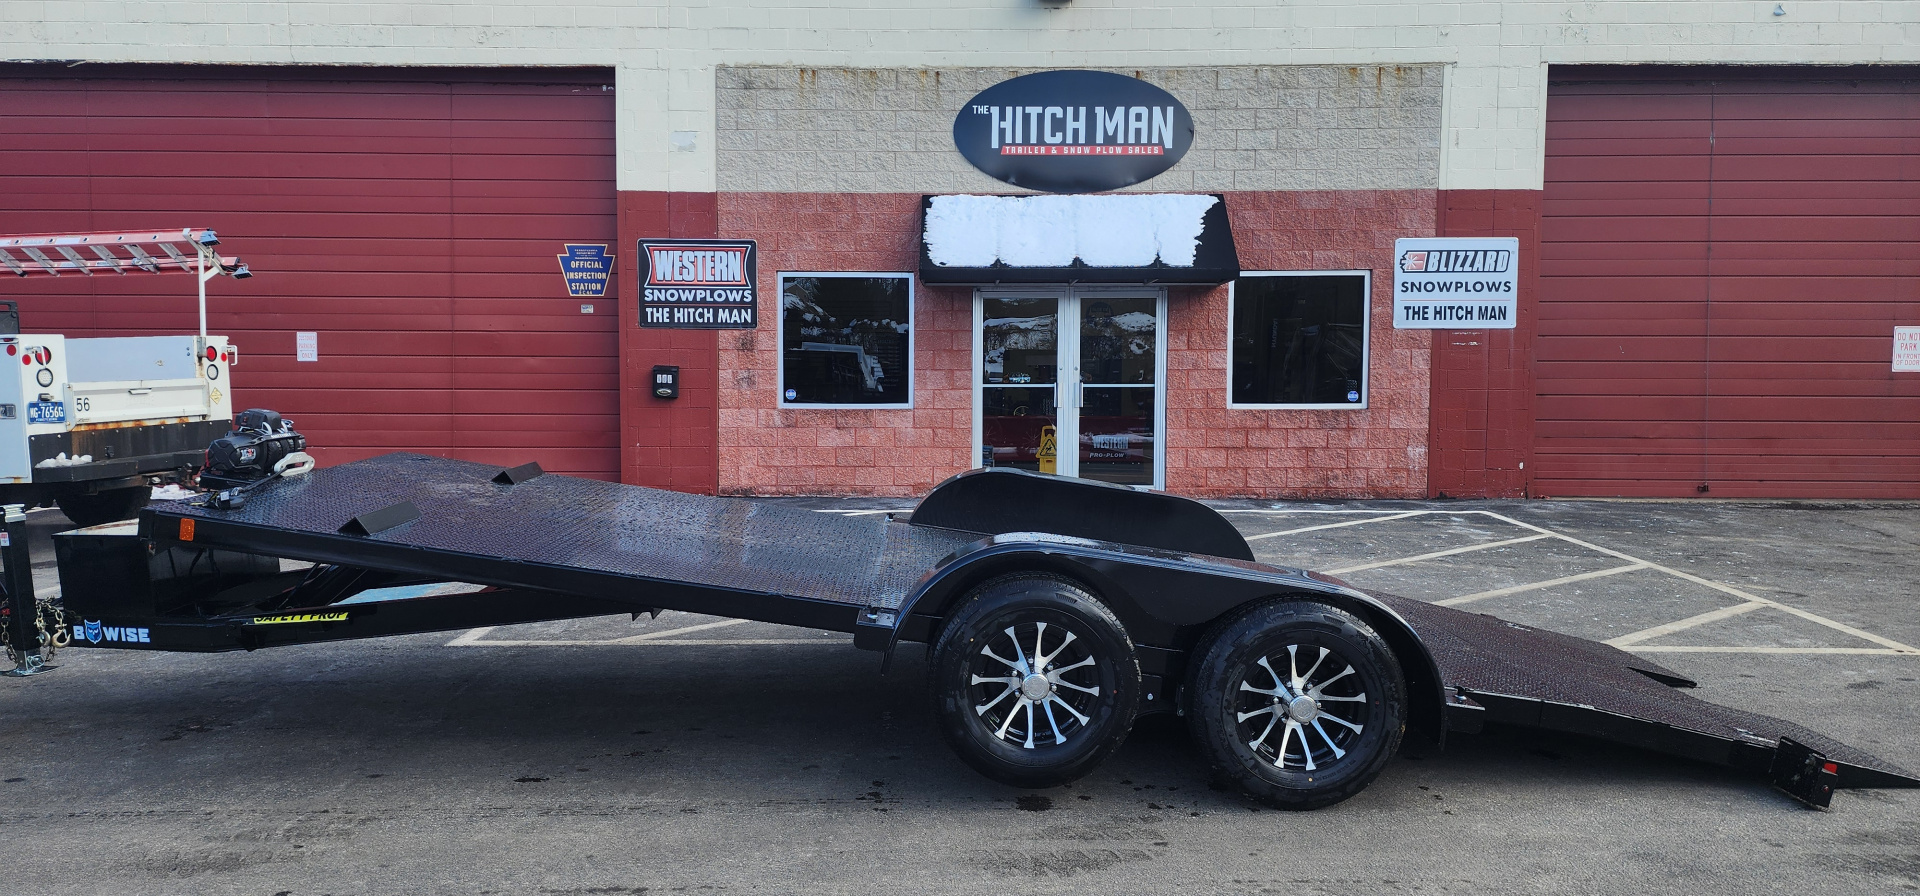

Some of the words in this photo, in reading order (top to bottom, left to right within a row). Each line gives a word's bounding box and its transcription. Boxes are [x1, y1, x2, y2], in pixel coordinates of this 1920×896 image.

[972, 105, 990, 115] THE
[990, 106, 1087, 149] HITCH
[1095, 106, 1175, 149] MAN
[1005, 146, 1046, 154] TRAILER
[1051, 146, 1058, 154] &
[1063, 146, 1091, 154] SNOW
[1096, 146, 1123, 154] PLOW
[1128, 146, 1159, 154] SALES
[570, 260, 604, 269] OFFICIAL
[653, 250, 742, 282] WESTERN
[1426, 251, 1510, 272] BLIZZARD
[566, 272, 607, 280] INSPECTION
[571, 282, 602, 291] STATION
[1400, 281, 1512, 293] SNOWPLOWS
[644, 289, 753, 302] SNOWPLOWS
[645, 307, 670, 323] THE
[674, 308, 713, 323] HITCH
[717, 308, 752, 324] MAN
[1404, 305, 1429, 321] THE
[1433, 305, 1474, 321] HITCH
[1478, 305, 1507, 321] MAN
[76, 397, 90, 412] 56
[1092, 436, 1128, 449] WESTERN
